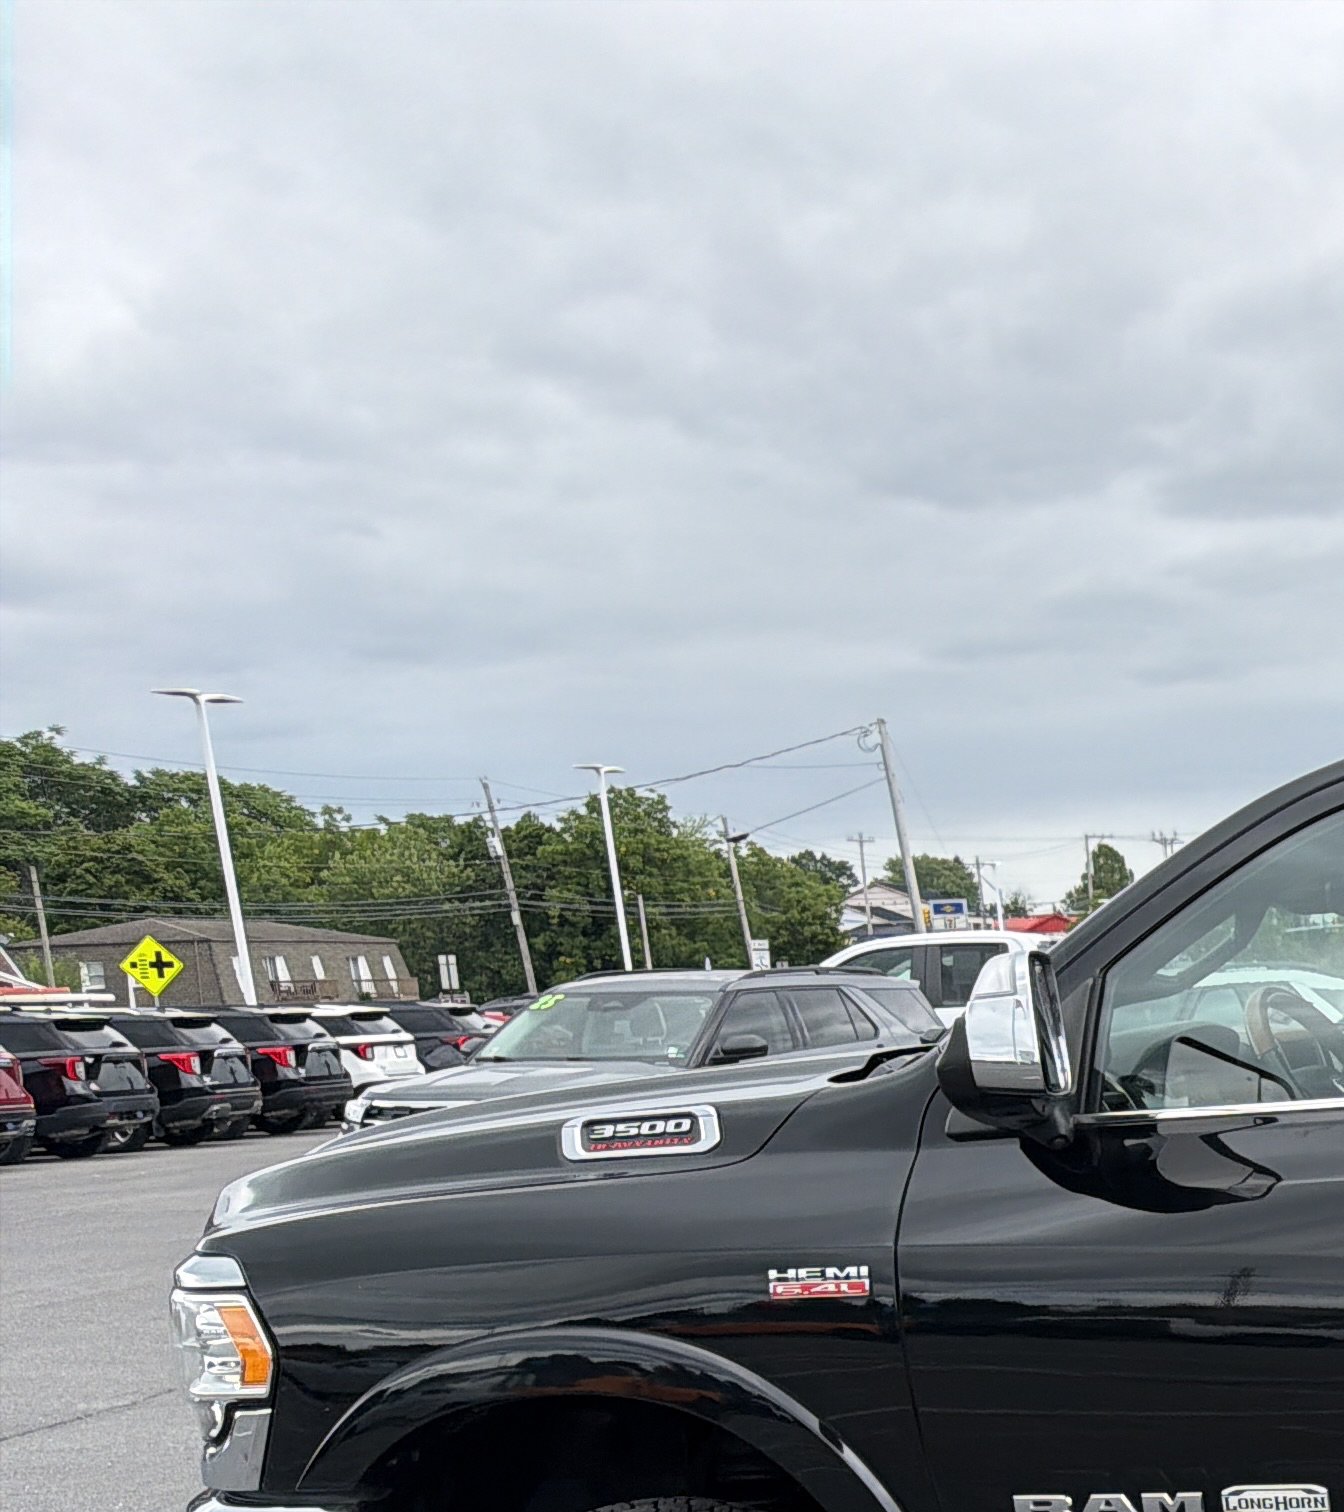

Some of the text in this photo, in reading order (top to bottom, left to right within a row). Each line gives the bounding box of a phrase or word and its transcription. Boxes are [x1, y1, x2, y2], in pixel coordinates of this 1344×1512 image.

[589, 1118, 692, 1139] 3500
[768, 1265, 869, 1281] HEMI
[1224, 1494, 1327, 1512] LONGHORN
